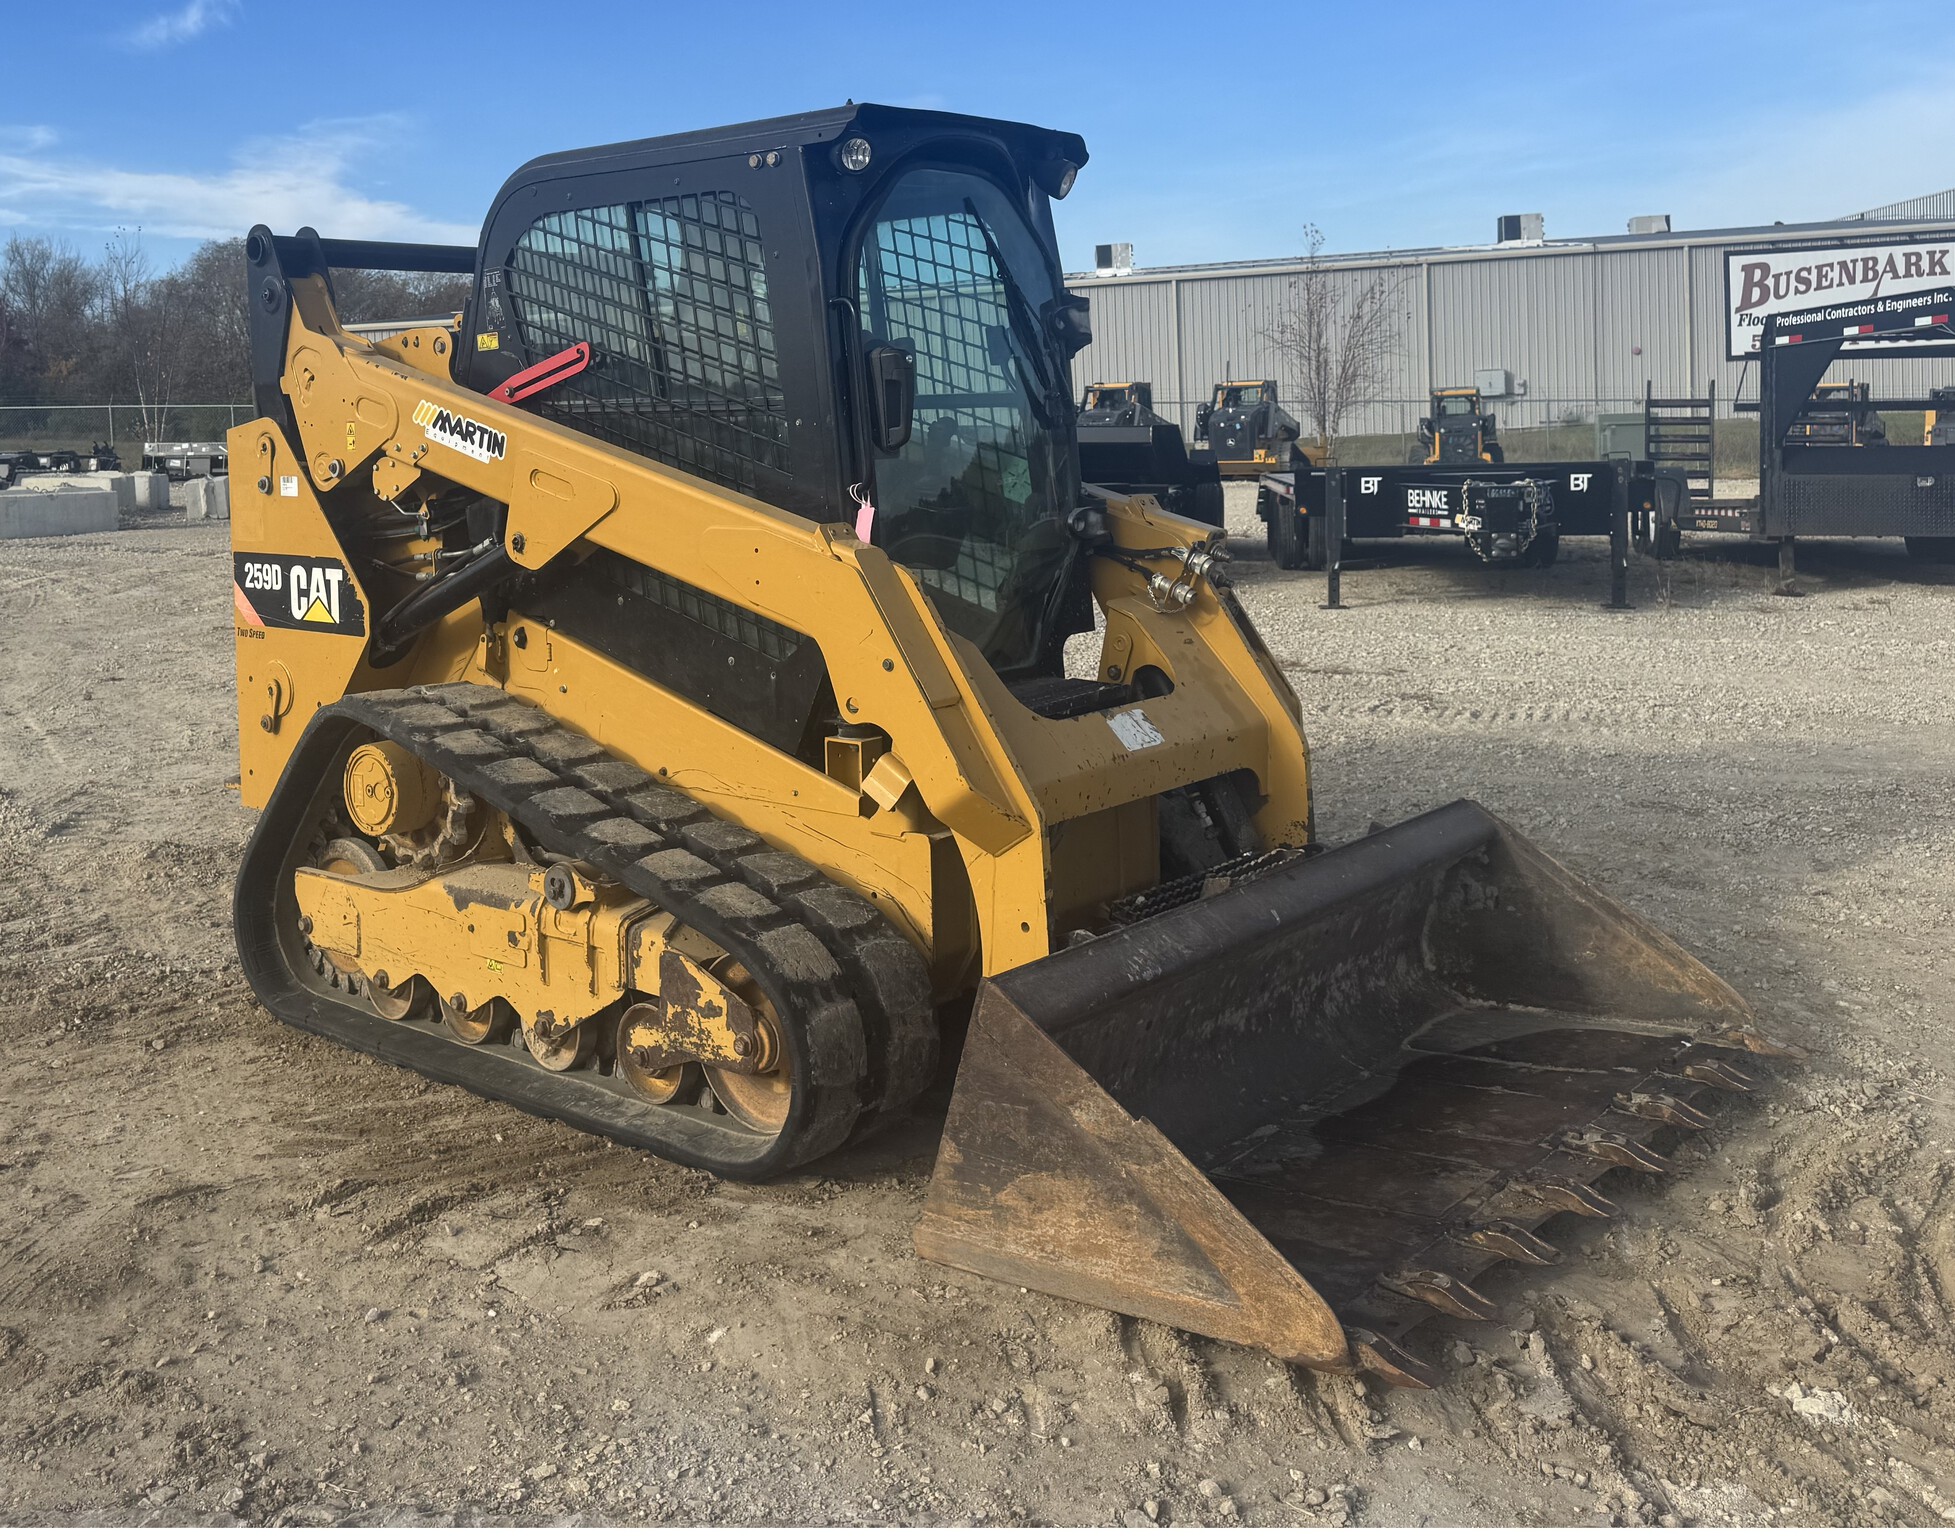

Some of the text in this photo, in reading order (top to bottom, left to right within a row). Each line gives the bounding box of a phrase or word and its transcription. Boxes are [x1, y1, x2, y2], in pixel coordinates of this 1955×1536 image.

[1735, 249, 1950, 314] BUSENBARK
[1776, 292, 1952, 327] Professional Contractors & Engineers Inc.
[432, 410, 505, 458] MARTIN
[1361, 477, 1383, 495] BT
[1407, 489, 1449, 509] BEHNKE
[1570, 474, 1593, 496] BT
[244, 562, 343, 625] 259D CAT
